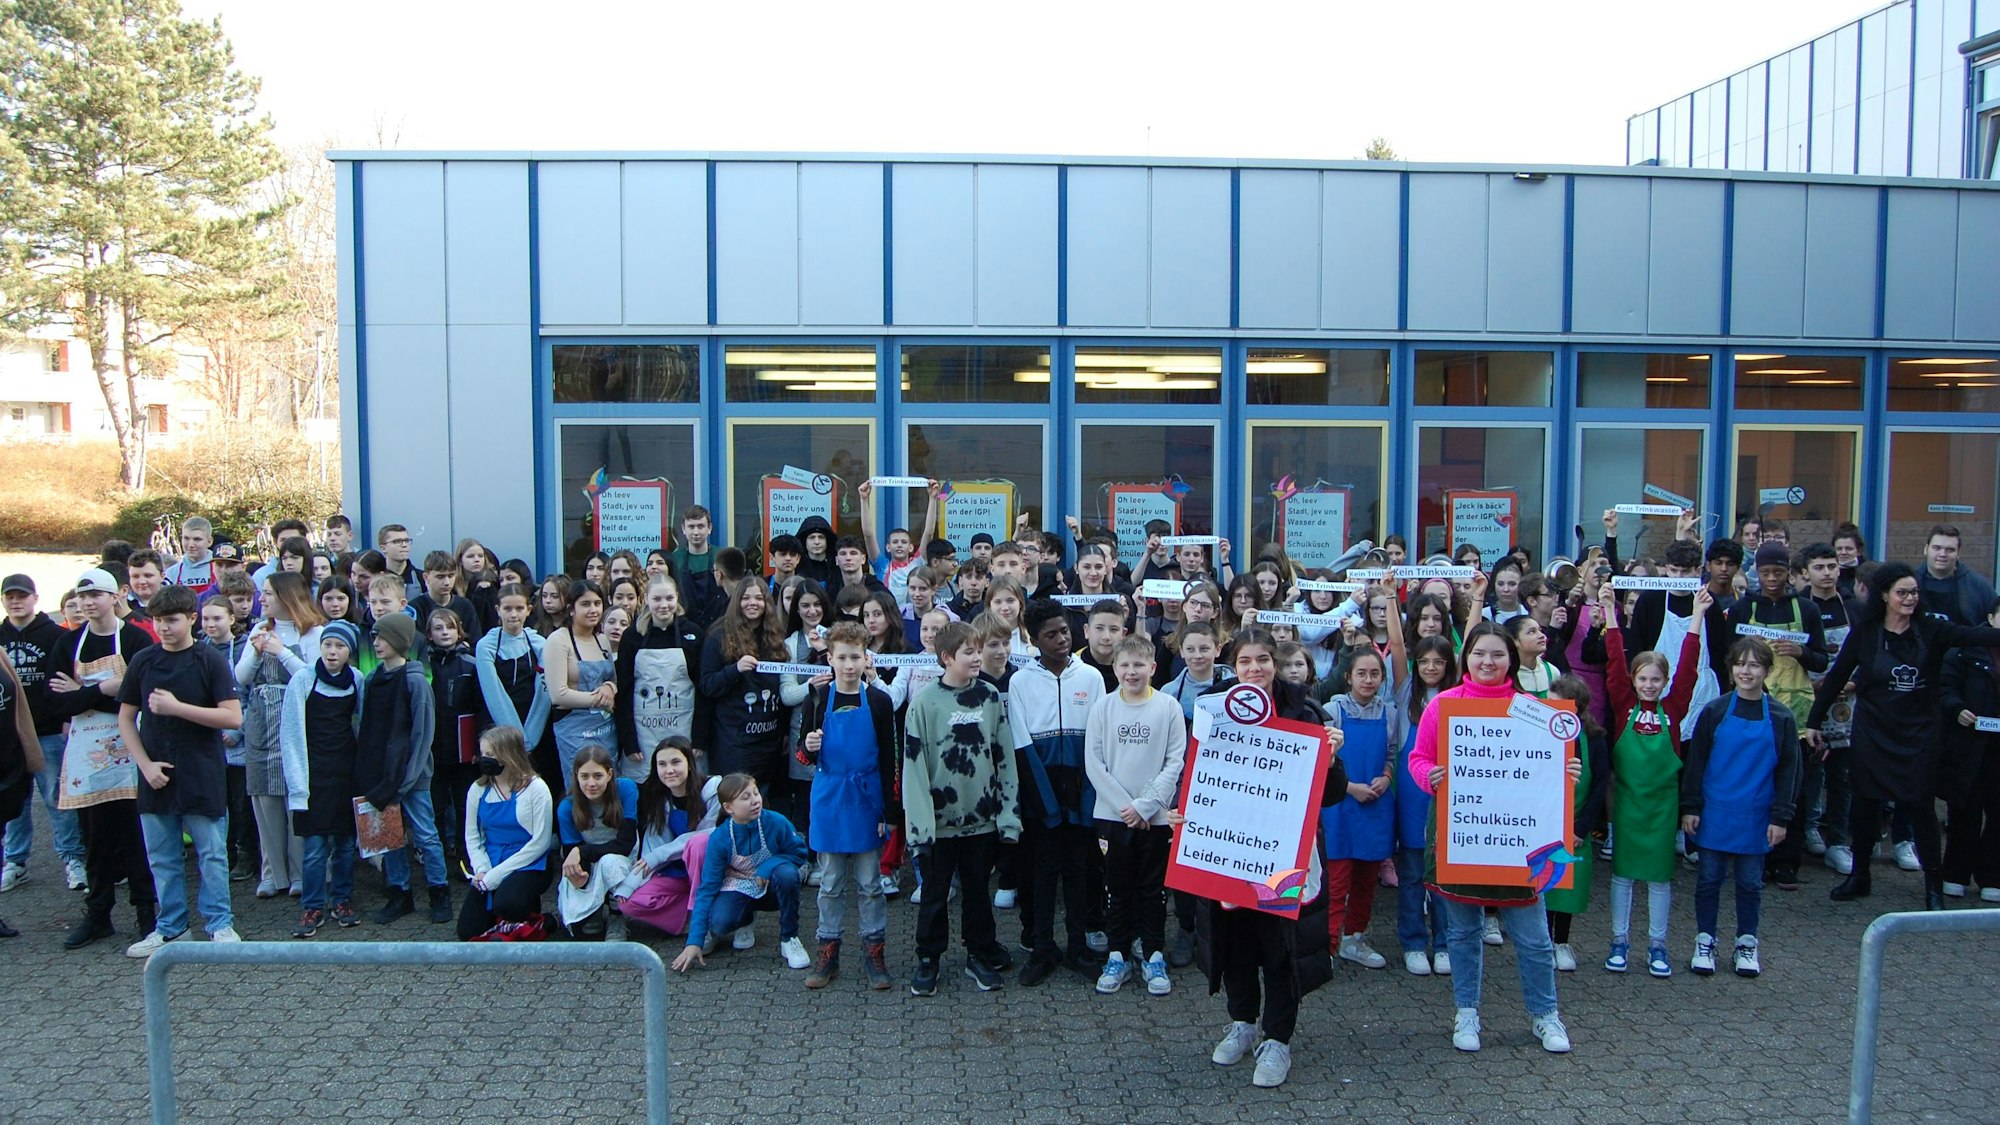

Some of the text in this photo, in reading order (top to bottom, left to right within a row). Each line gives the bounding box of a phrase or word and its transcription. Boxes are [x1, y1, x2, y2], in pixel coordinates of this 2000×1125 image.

[614, 491, 631, 499] leev
[772, 493, 804, 501] Oh, leev
[602, 502, 624, 511] Stadt,
[626, 503, 638, 511] jev
[772, 505, 795, 513] Stadt,
[797, 505, 809, 513] jev
[1141, 508, 1153, 516] jev
[1311, 508, 1322, 516] jev
[1635, 506, 1680, 514] Trinkwasser
[772, 528, 789, 536] janz
[1287, 540, 1330, 548] Schulküsch
[1393, 567, 1414, 576] Kein
[1416, 567, 1473, 577] Trinkwasser
[1297, 580, 1312, 588] Kein
[1614, 578, 1699, 589] Kein Trinkwasser
[1260, 612, 1338, 626] Kein Trinkwasser
[1738, 626, 1807, 641] Kein Trinkwasser
[874, 656, 936, 665] Kein Trinkwass
[759, 664, 829, 674] Kein Trinkwasser
[1526, 703, 1540, 713] Kein
[1513, 706, 1548, 725] Trinkwasser
[641, 716, 678, 728] COOKING
[745, 719, 778, 734] COOKING
[1979, 720, 1998, 729] Kein
[1118, 722, 1151, 738] edc
[1454, 724, 1512, 739] Oh, leev
[1118, 737, 1127, 745] by
[1249, 734, 1262, 747] is
[1454, 745, 1552, 761] Stadt, jev uns
[1202, 748, 1283, 774] an der IGP!
[1513, 767, 1530, 780] de
[1197, 771, 1288, 802] Unterricht in
[1193, 793, 1217, 807] der
[1453, 791, 1483, 806] janz
[1453, 811, 1537, 827] Schulküsch
[1187, 821, 1280, 852] Schulküche?
[1453, 832, 1529, 848] lijet drüch.
[1183, 845, 1275, 877] Leider nicht!
